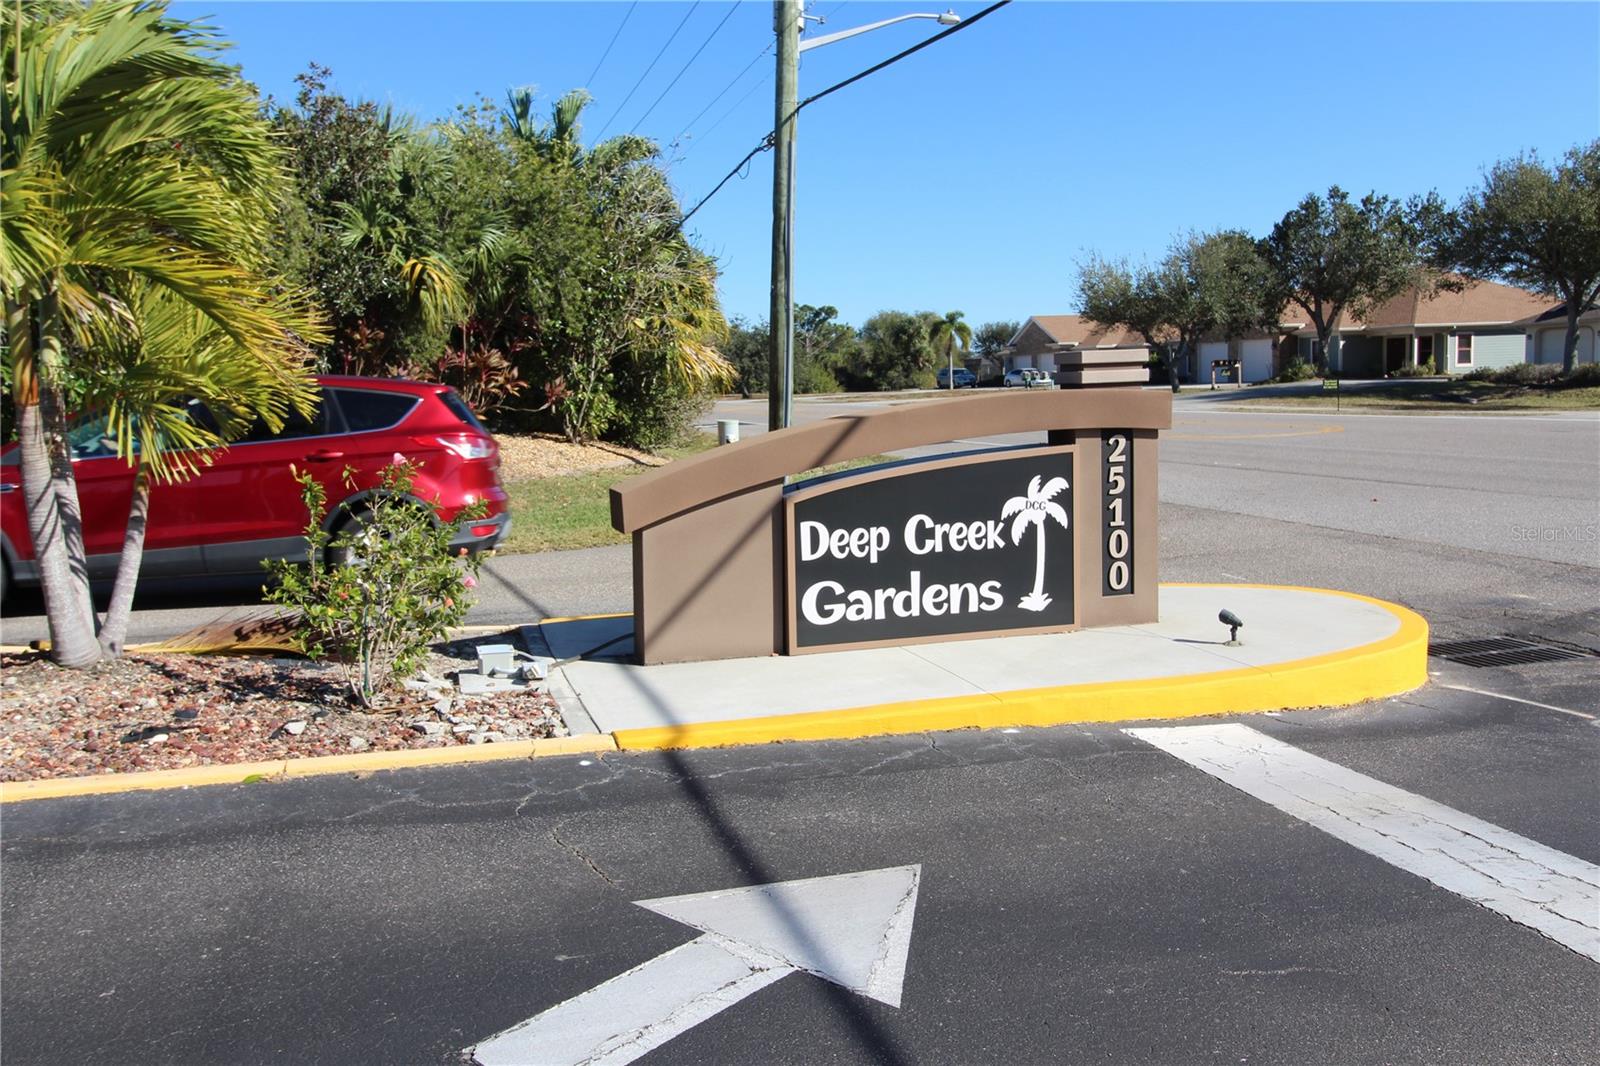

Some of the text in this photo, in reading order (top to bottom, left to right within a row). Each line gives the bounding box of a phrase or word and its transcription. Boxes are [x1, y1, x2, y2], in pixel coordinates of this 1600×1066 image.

[1025, 500, 1047, 511] DCG
[1107, 434, 1129, 590] 25100
[800, 513, 1006, 564] Deep Creek
[801, 570, 1004, 626] Gardens
